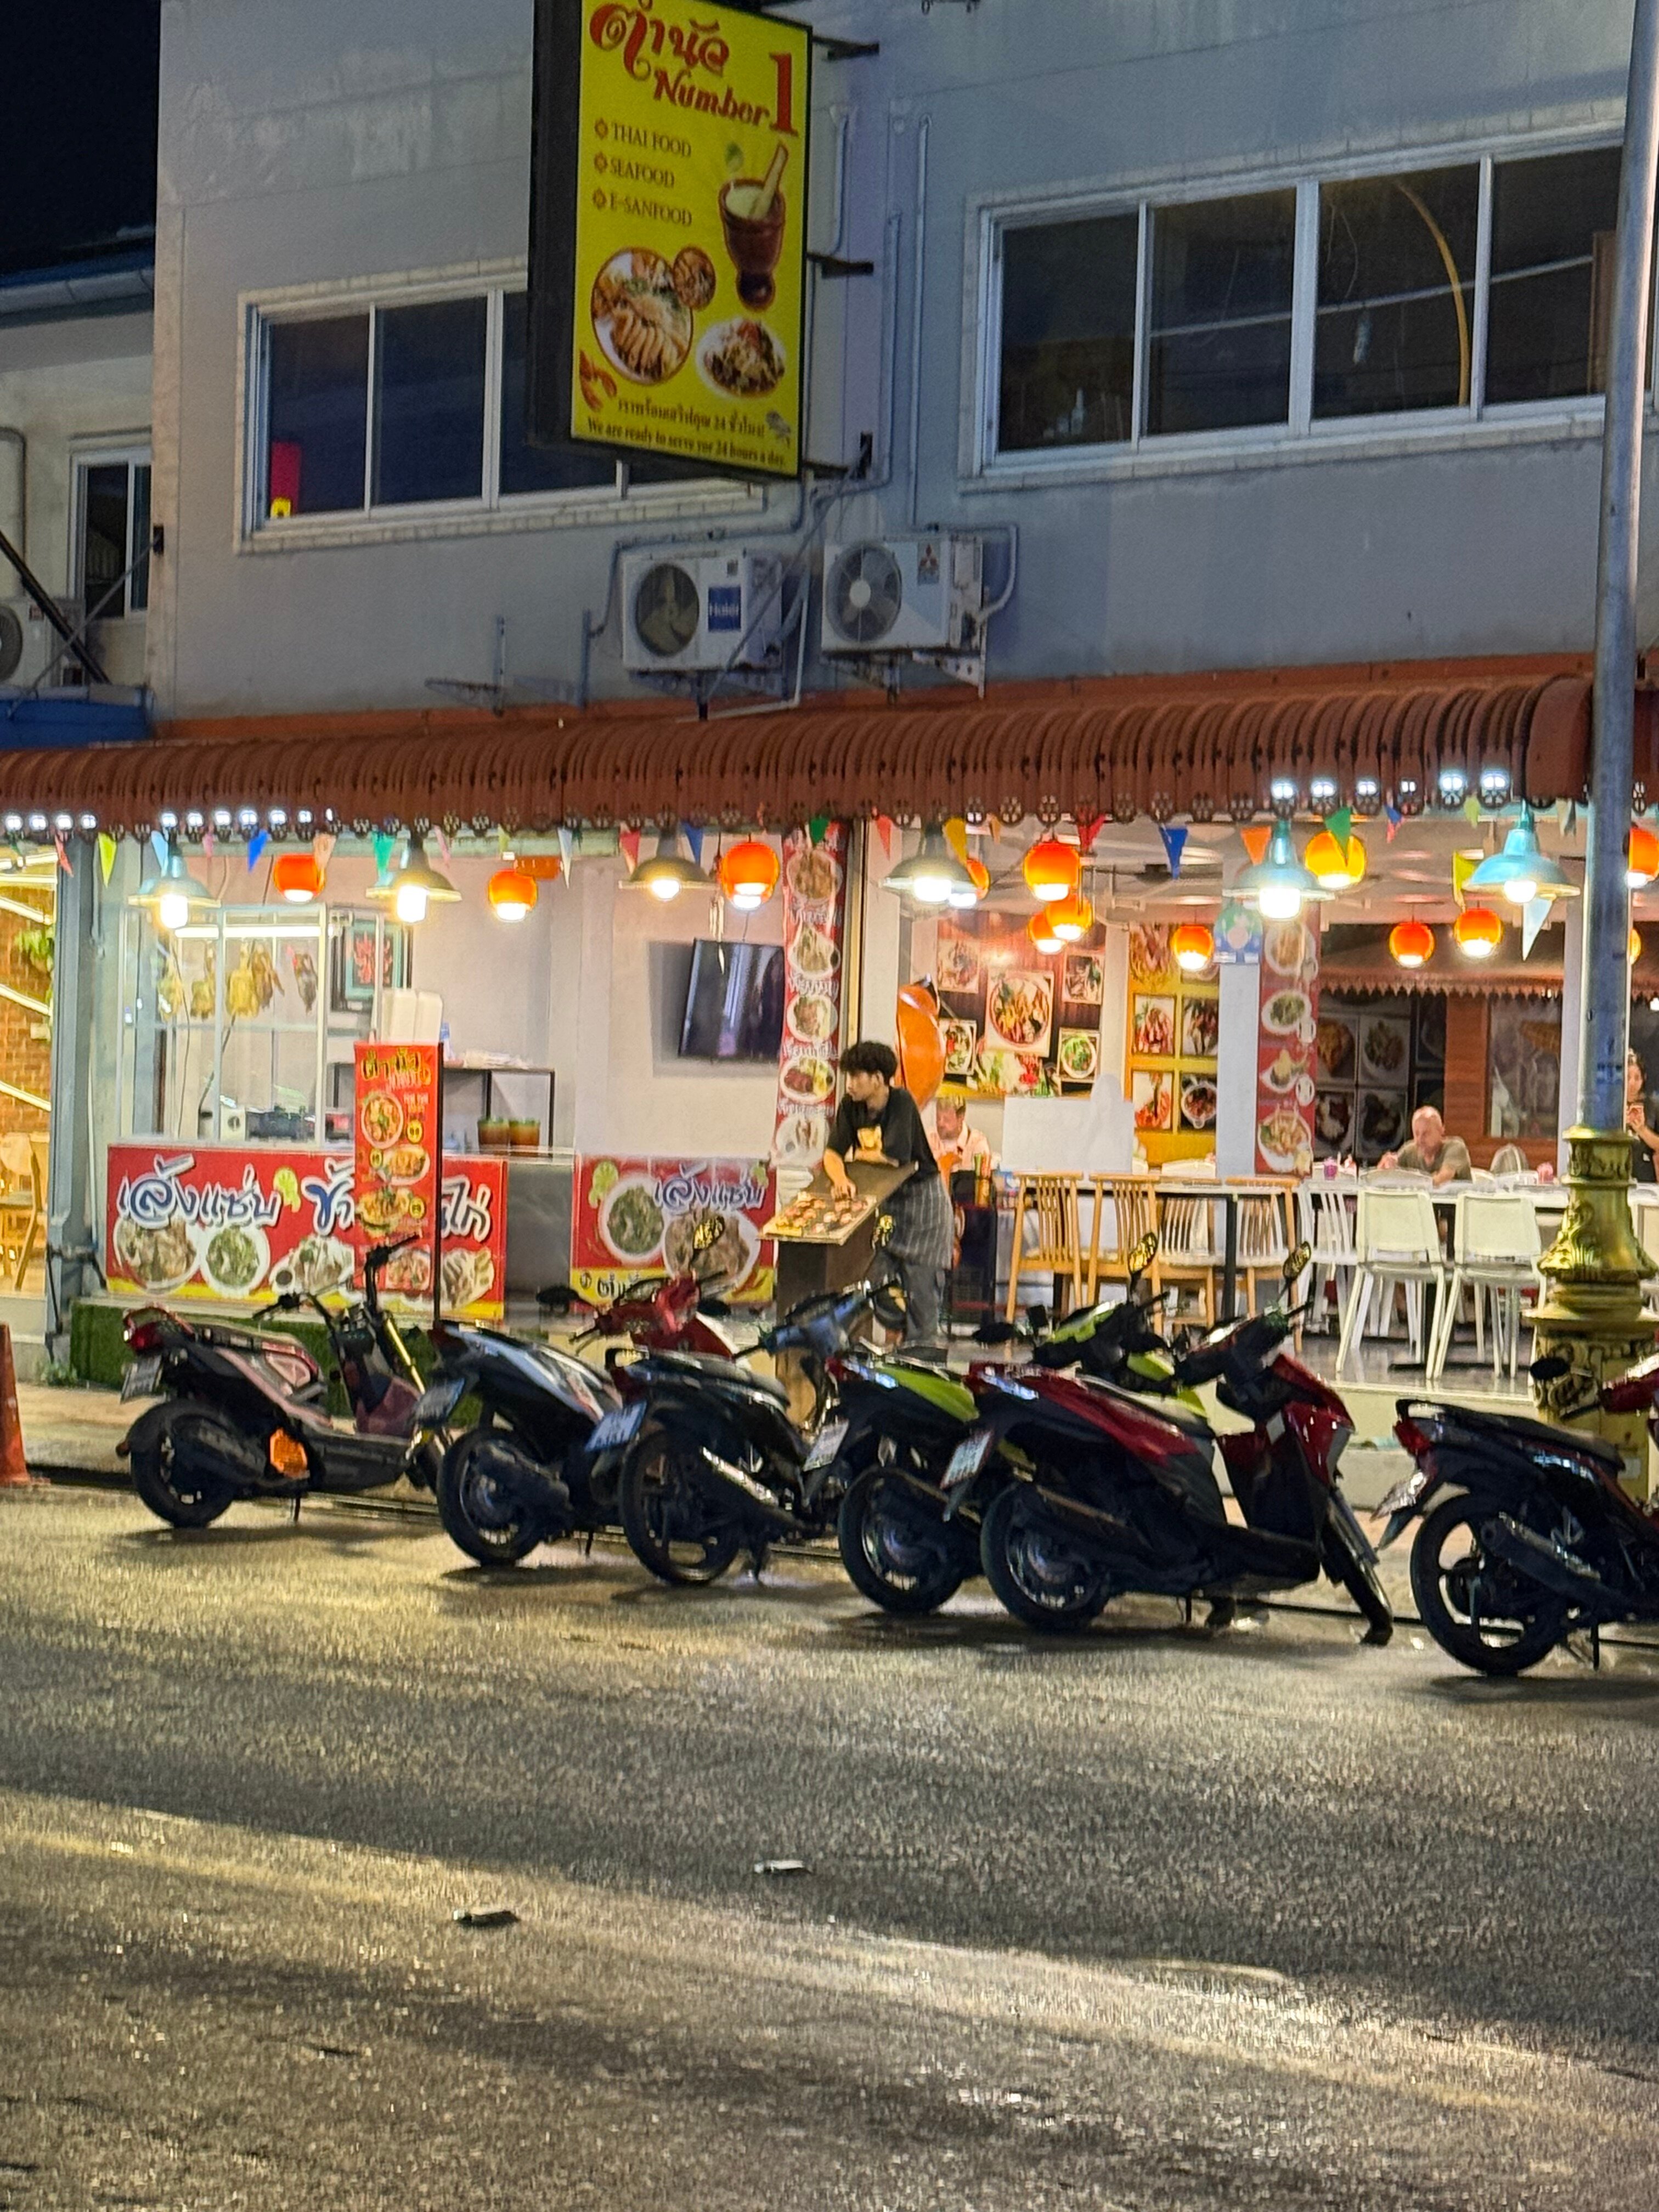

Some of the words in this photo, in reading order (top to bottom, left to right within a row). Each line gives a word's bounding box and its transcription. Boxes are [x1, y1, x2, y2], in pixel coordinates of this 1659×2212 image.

[653, 67, 770, 126] Number
[769, 52, 799, 137] 1
[611, 122, 648, 147] THAI
[652, 133, 692, 159] FOOD
[610, 158, 675, 189] SEAFOOD
[588, 416, 603, 435] We
[606, 424, 623, 438] are
[625, 425, 652, 449] ready
